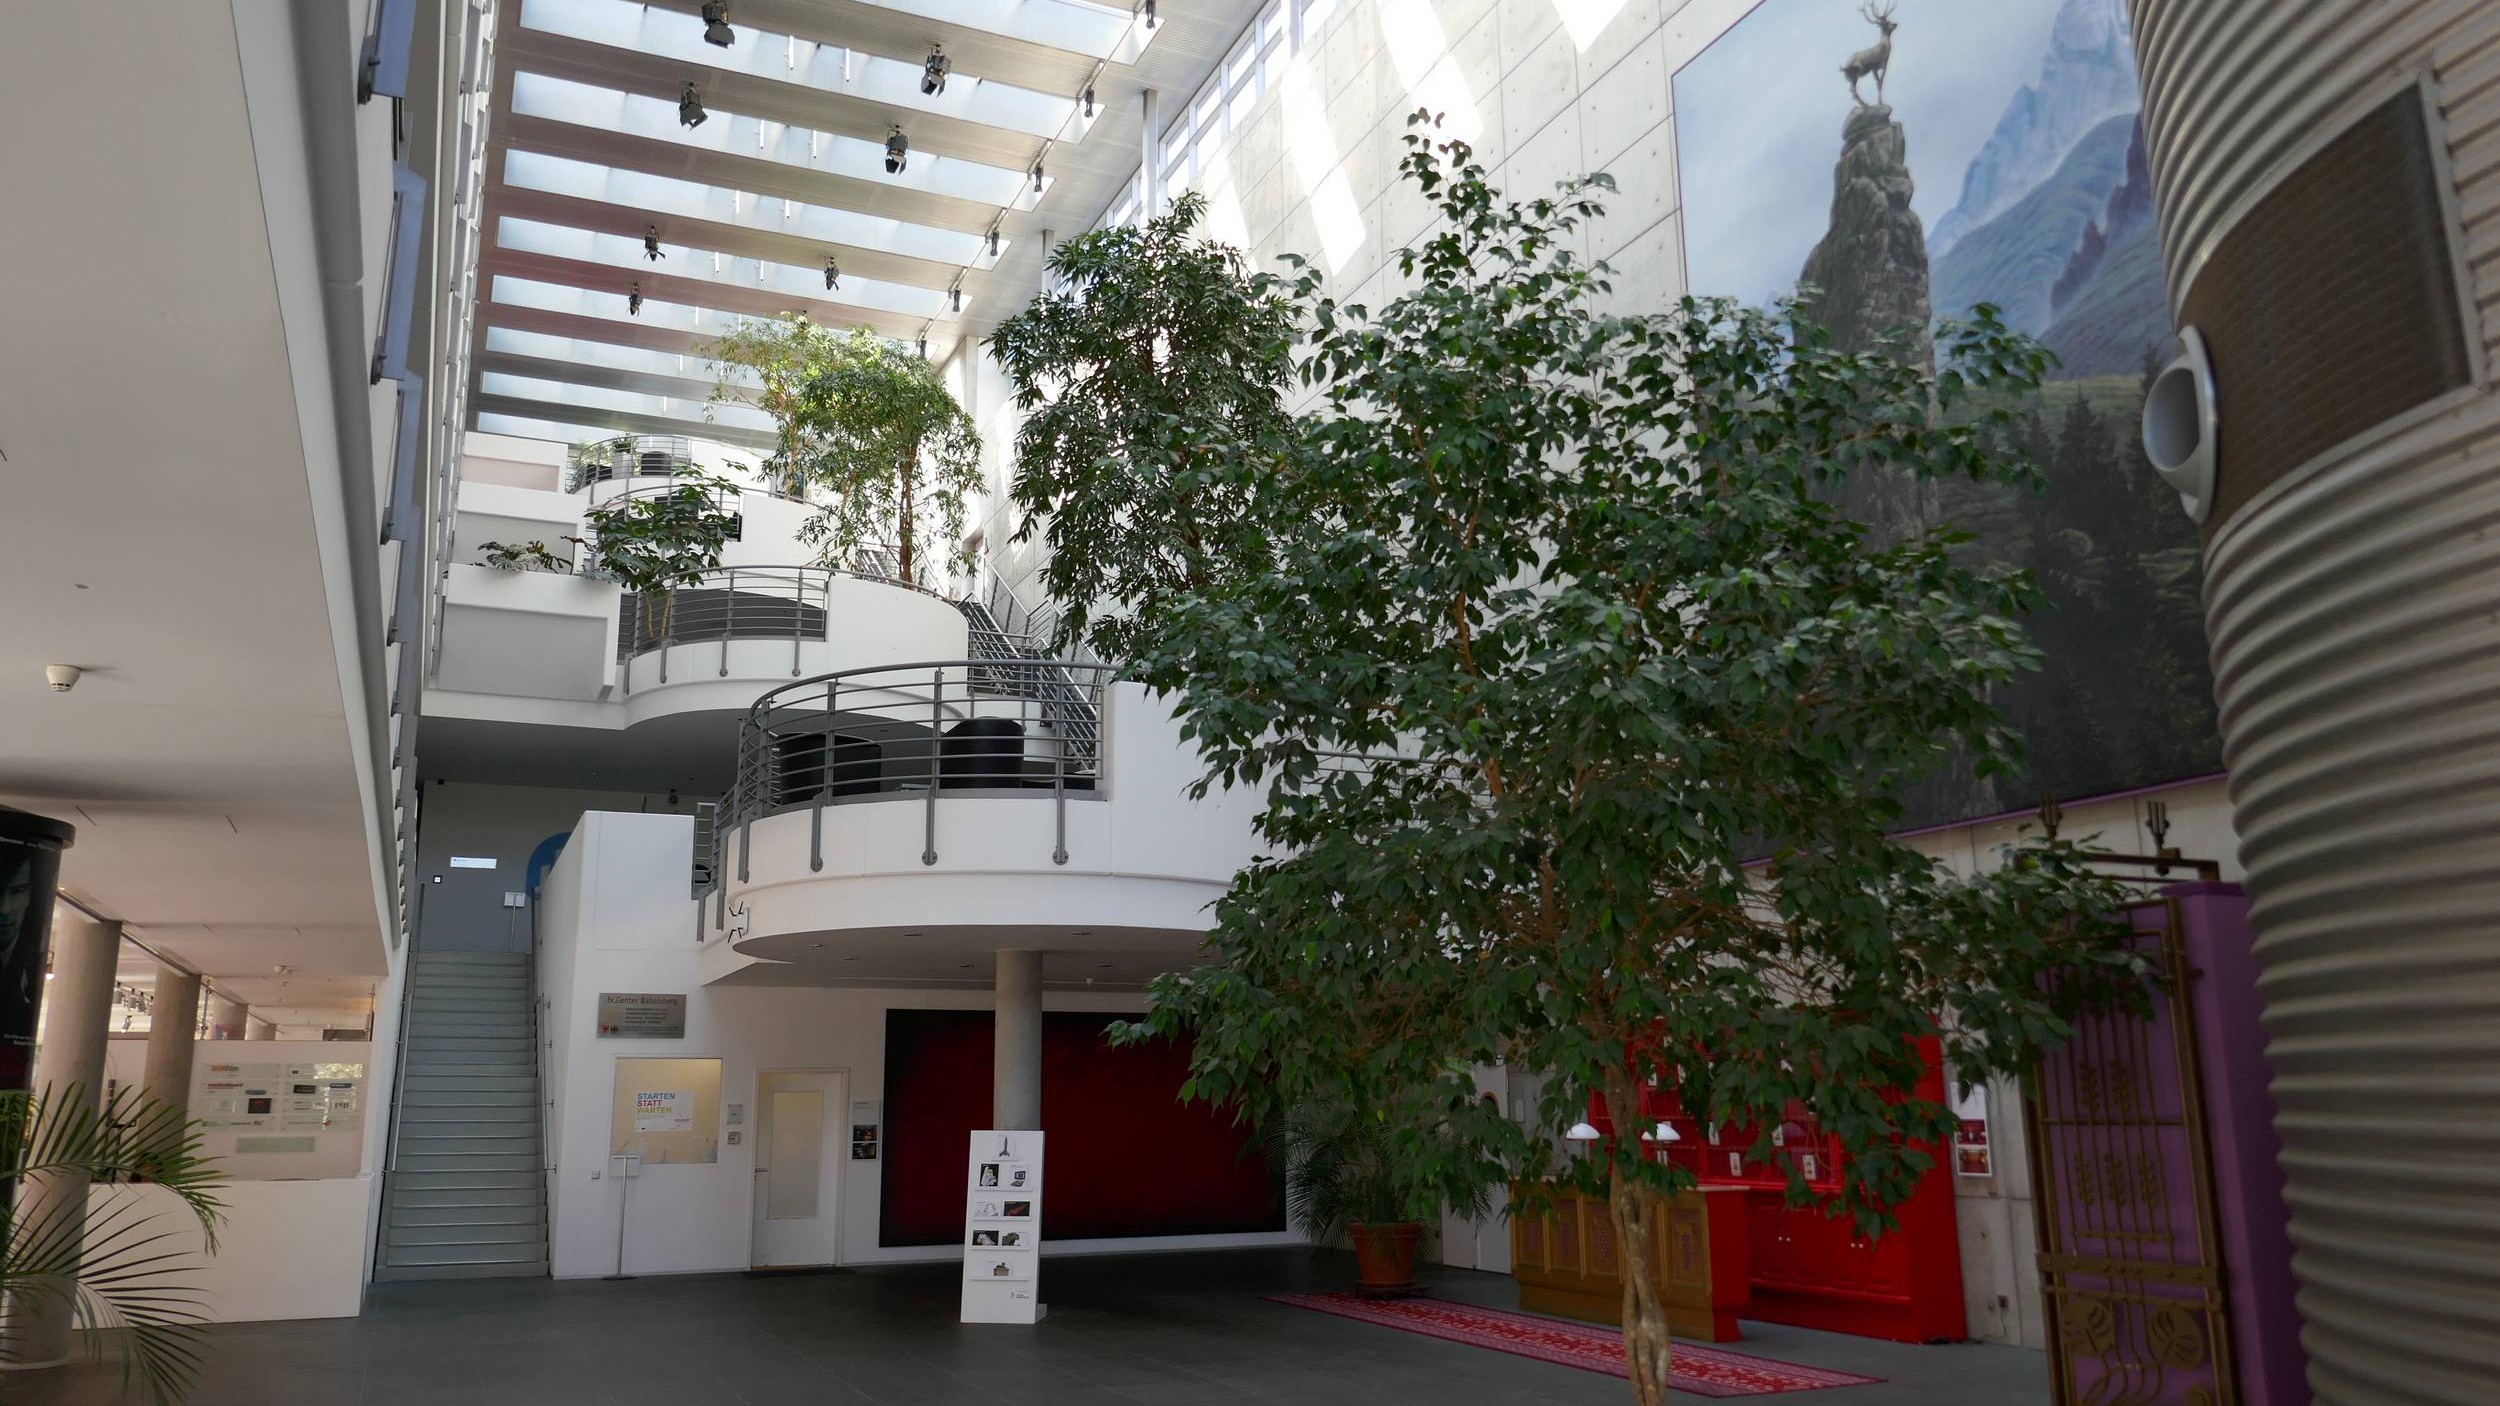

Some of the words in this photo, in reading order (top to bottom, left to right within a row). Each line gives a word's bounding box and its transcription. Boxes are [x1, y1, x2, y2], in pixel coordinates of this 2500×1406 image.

[637, 1092, 675, 1100] STARTEN
[637, 1099, 662, 1107] STATT
[636, 1106, 672, 1114] WARTEN
